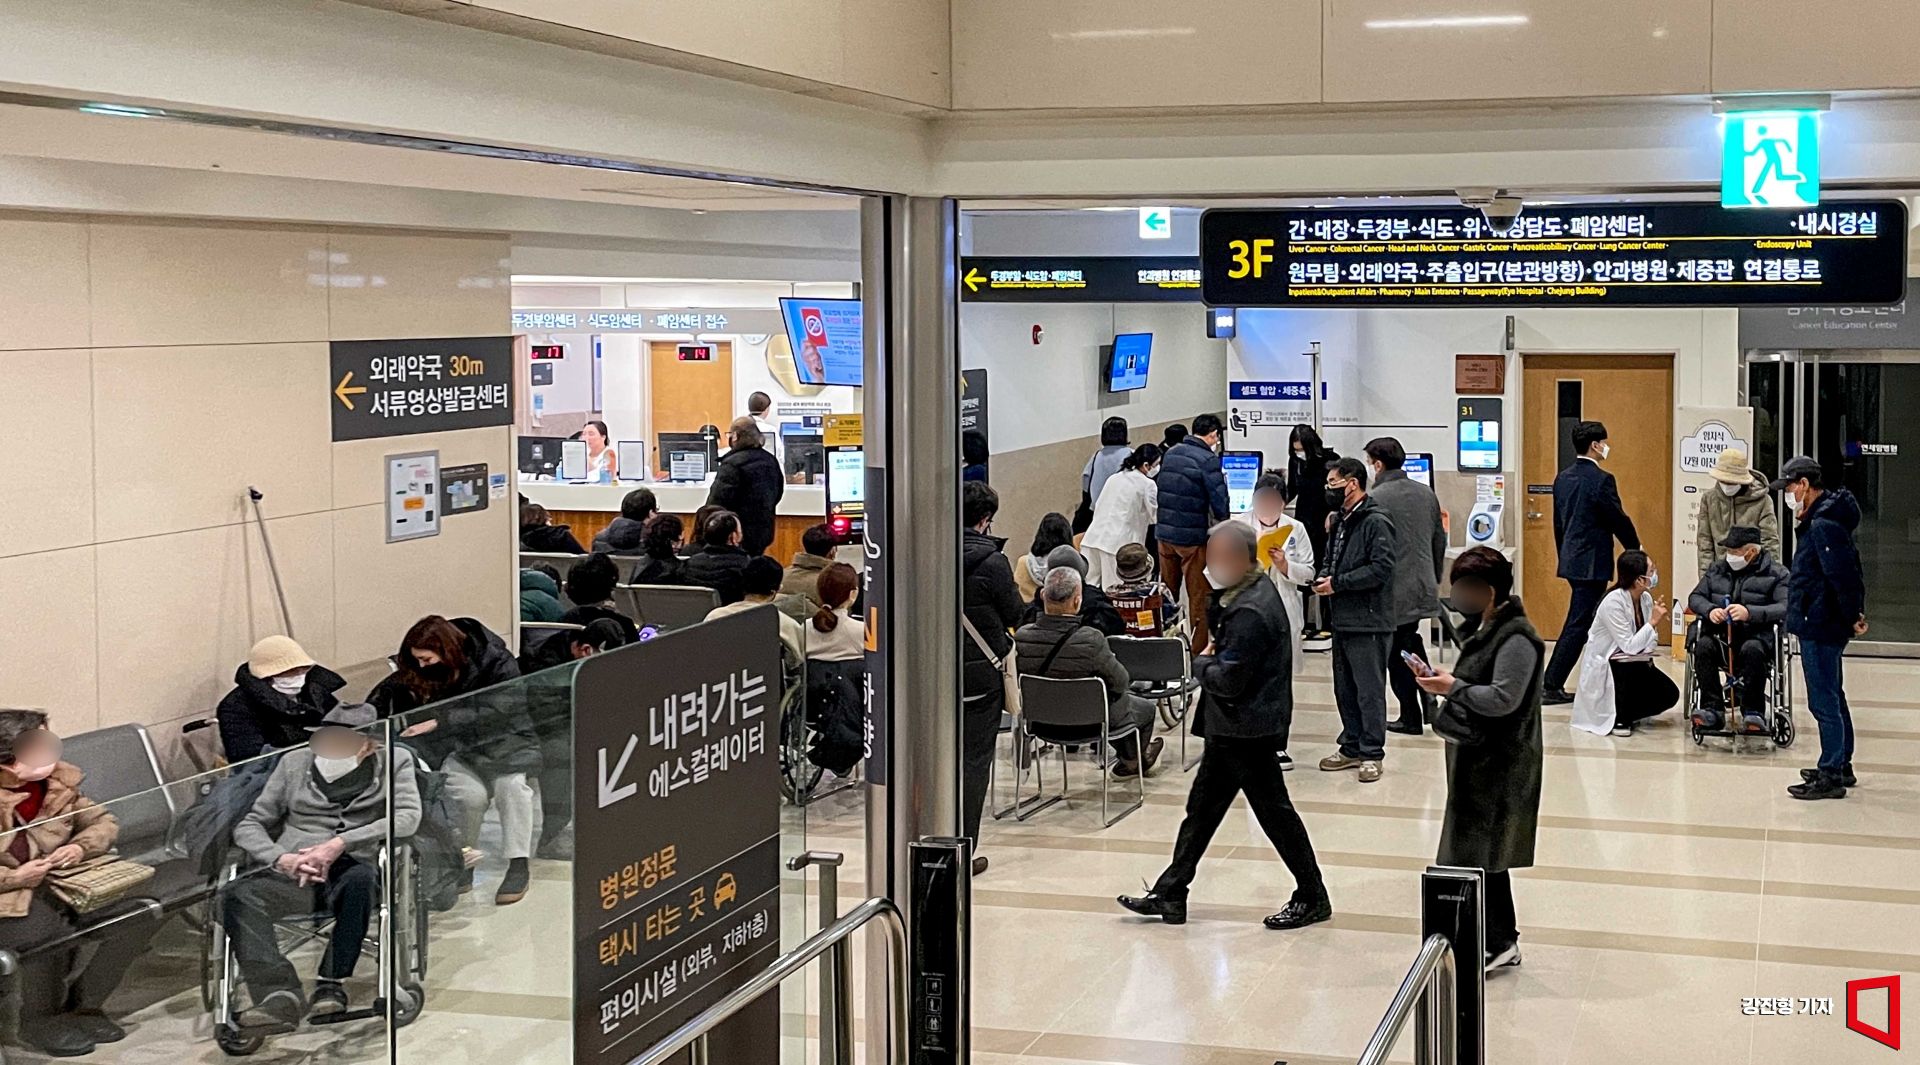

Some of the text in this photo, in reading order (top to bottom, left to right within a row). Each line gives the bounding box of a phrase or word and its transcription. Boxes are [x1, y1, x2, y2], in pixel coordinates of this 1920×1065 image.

[1228, 238, 1275, 278] 3F
[1288, 245, 1304, 253] Liver
[1406, 244, 1419, 252] and
[1420, 244, 1436, 252] Neck
[1618, 242, 1641, 250] Cancer
[1796, 240, 1812, 249] Unit
[1743, 259, 1822, 281] 연결통로
[587, 313, 642, 329] 식도암센터
[656, 313, 701, 329] 폐암센터
[704, 313, 728, 329] 접수
[1823, 320, 1867, 330] Education
[1868, 320, 1898, 330] Center
[547, 346, 560, 358] 17
[694, 348, 706, 359] 14
[369, 355, 484, 383] 외래약국 30m
[369, 383, 508, 418] 서류영상발급센터
[1461, 406, 1473, 416] 31
[649, 668, 767, 750] 내려가는
[648, 720, 765, 798] 에스컬레이터
[599, 844, 678, 910] 병원정문
[599, 886, 707, 966] 택시 타는 곳
[599, 909, 769, 1035] 편의시설 (외부, 지하1층)
